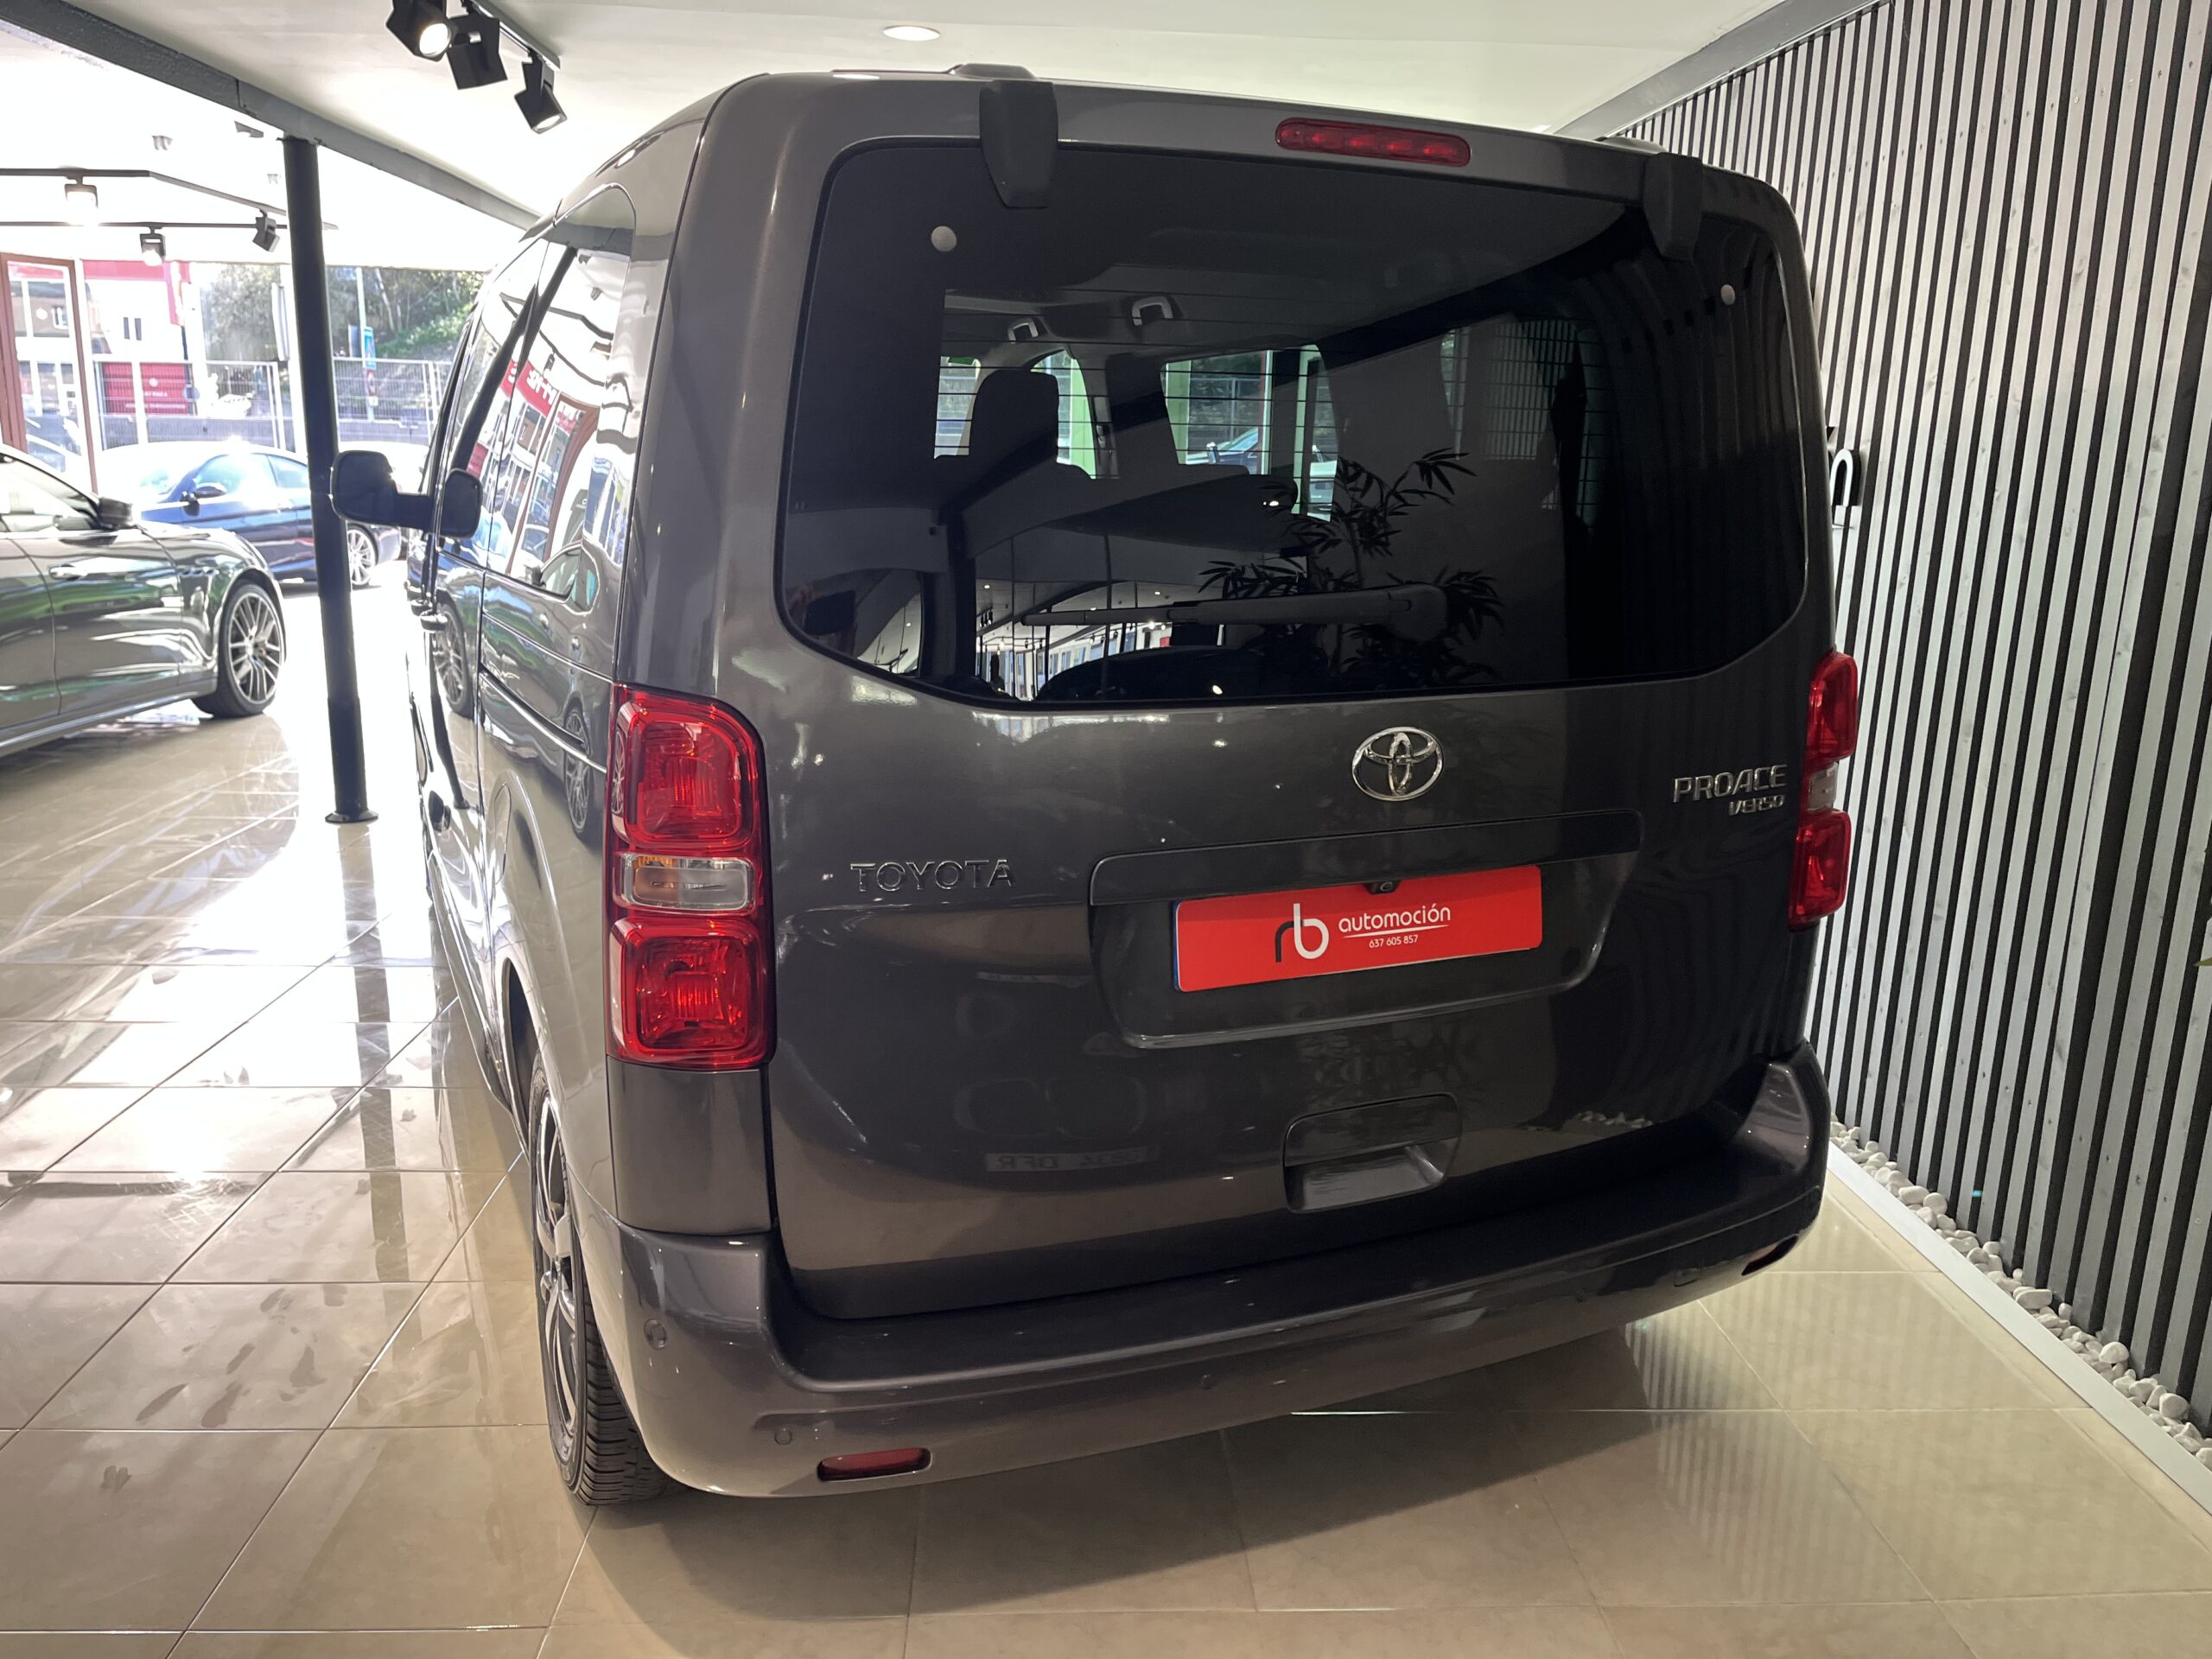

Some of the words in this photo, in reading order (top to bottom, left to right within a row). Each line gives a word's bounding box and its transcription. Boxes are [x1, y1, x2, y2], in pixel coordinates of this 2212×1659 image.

[1673, 764, 1788, 804] PROACE
[1729, 794, 1785, 816] VERSO
[850, 859, 1014, 893] TOYOTA
[1338, 903, 1452, 933] automoción
[1369, 938, 1384, 949] 637
[1386, 936, 1402, 947] 605
[1403, 934, 1419, 944] 857
